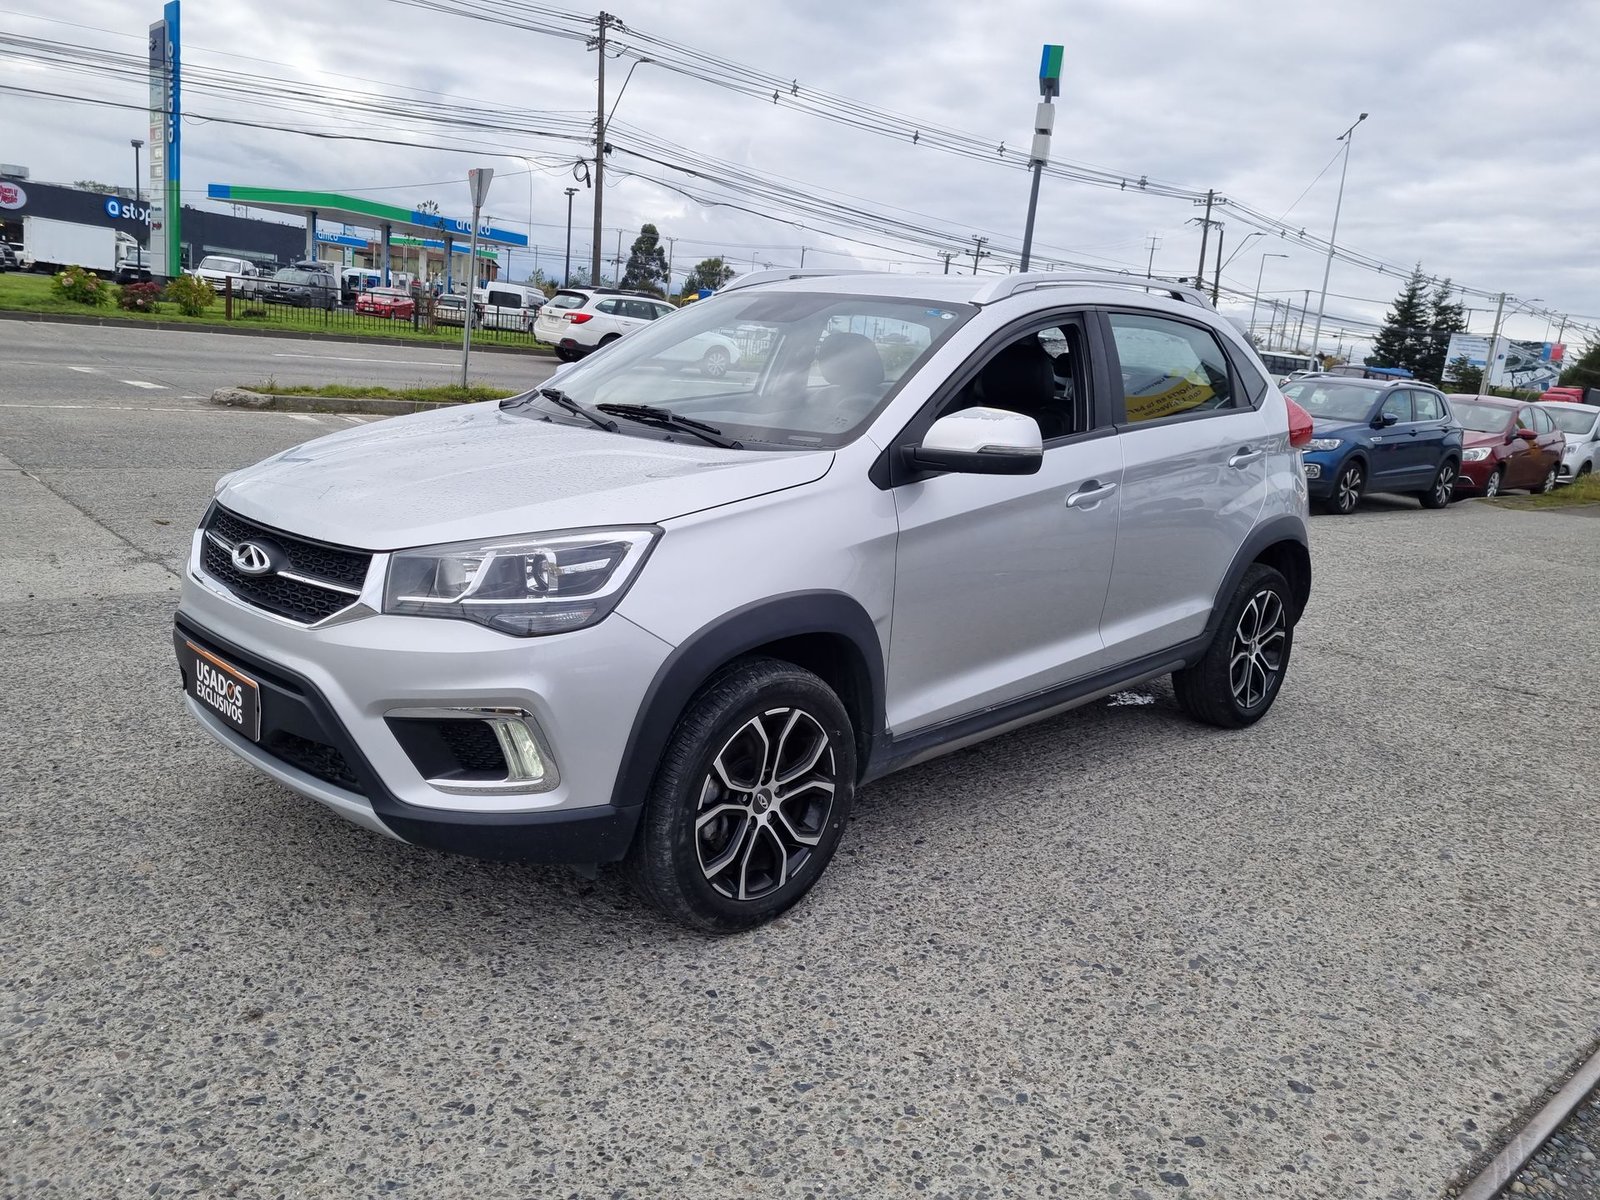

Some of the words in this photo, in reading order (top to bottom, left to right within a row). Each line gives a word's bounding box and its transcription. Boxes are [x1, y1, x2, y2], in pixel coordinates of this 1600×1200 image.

[122, 203, 151, 226] stop
[456, 219, 490, 236] araco
[196, 659, 242, 707] USADOS
[196, 680, 243, 725] EXCLUSIVOS
